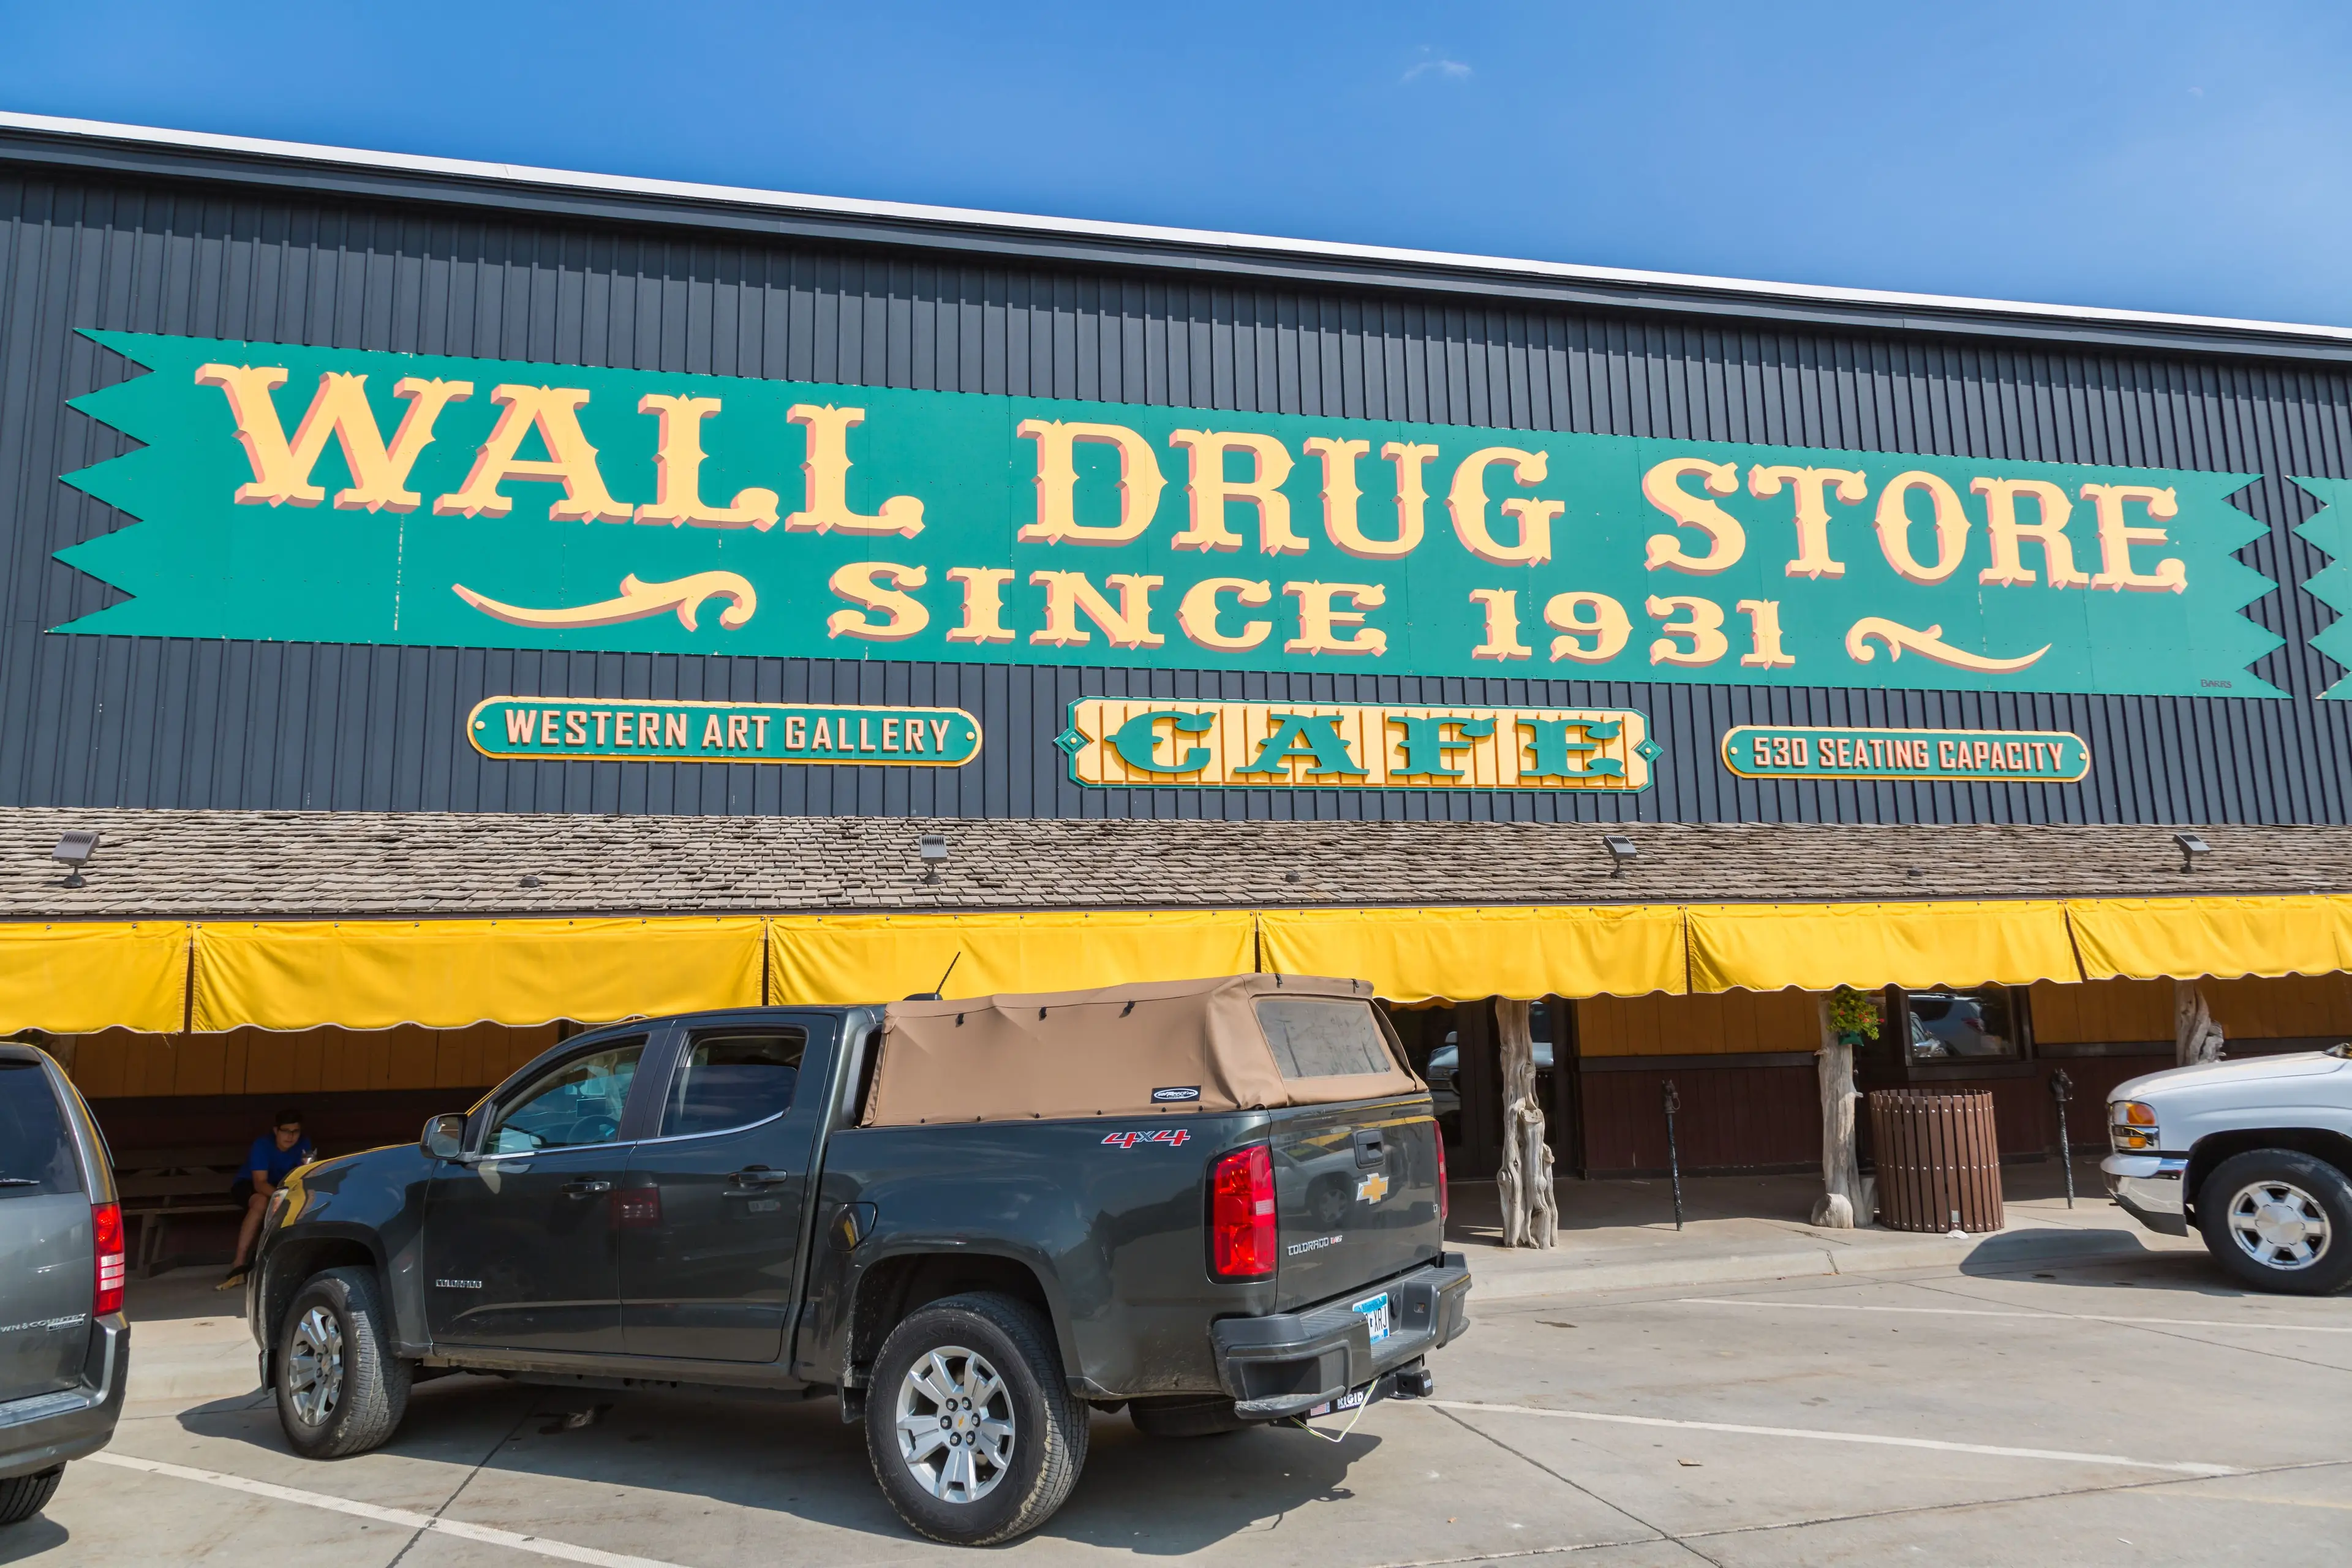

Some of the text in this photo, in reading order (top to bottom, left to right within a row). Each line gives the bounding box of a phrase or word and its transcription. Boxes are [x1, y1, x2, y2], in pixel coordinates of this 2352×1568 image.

[195, 363, 2188, 595] WALL DRUG STORE
[827, 562, 1795, 670] SINCE 1931
[505, 709, 951, 753] WESTERN ART GALLERY
[1103, 710, 1627, 778] CAFE
[1753, 737, 2064, 772] 530 SEATING CAPACITY
[1288, 1237, 1329, 1256] COLORADO
[436, 1280, 482, 1288] COLORADO
[1337, 1391, 1364, 1407] RIGID
